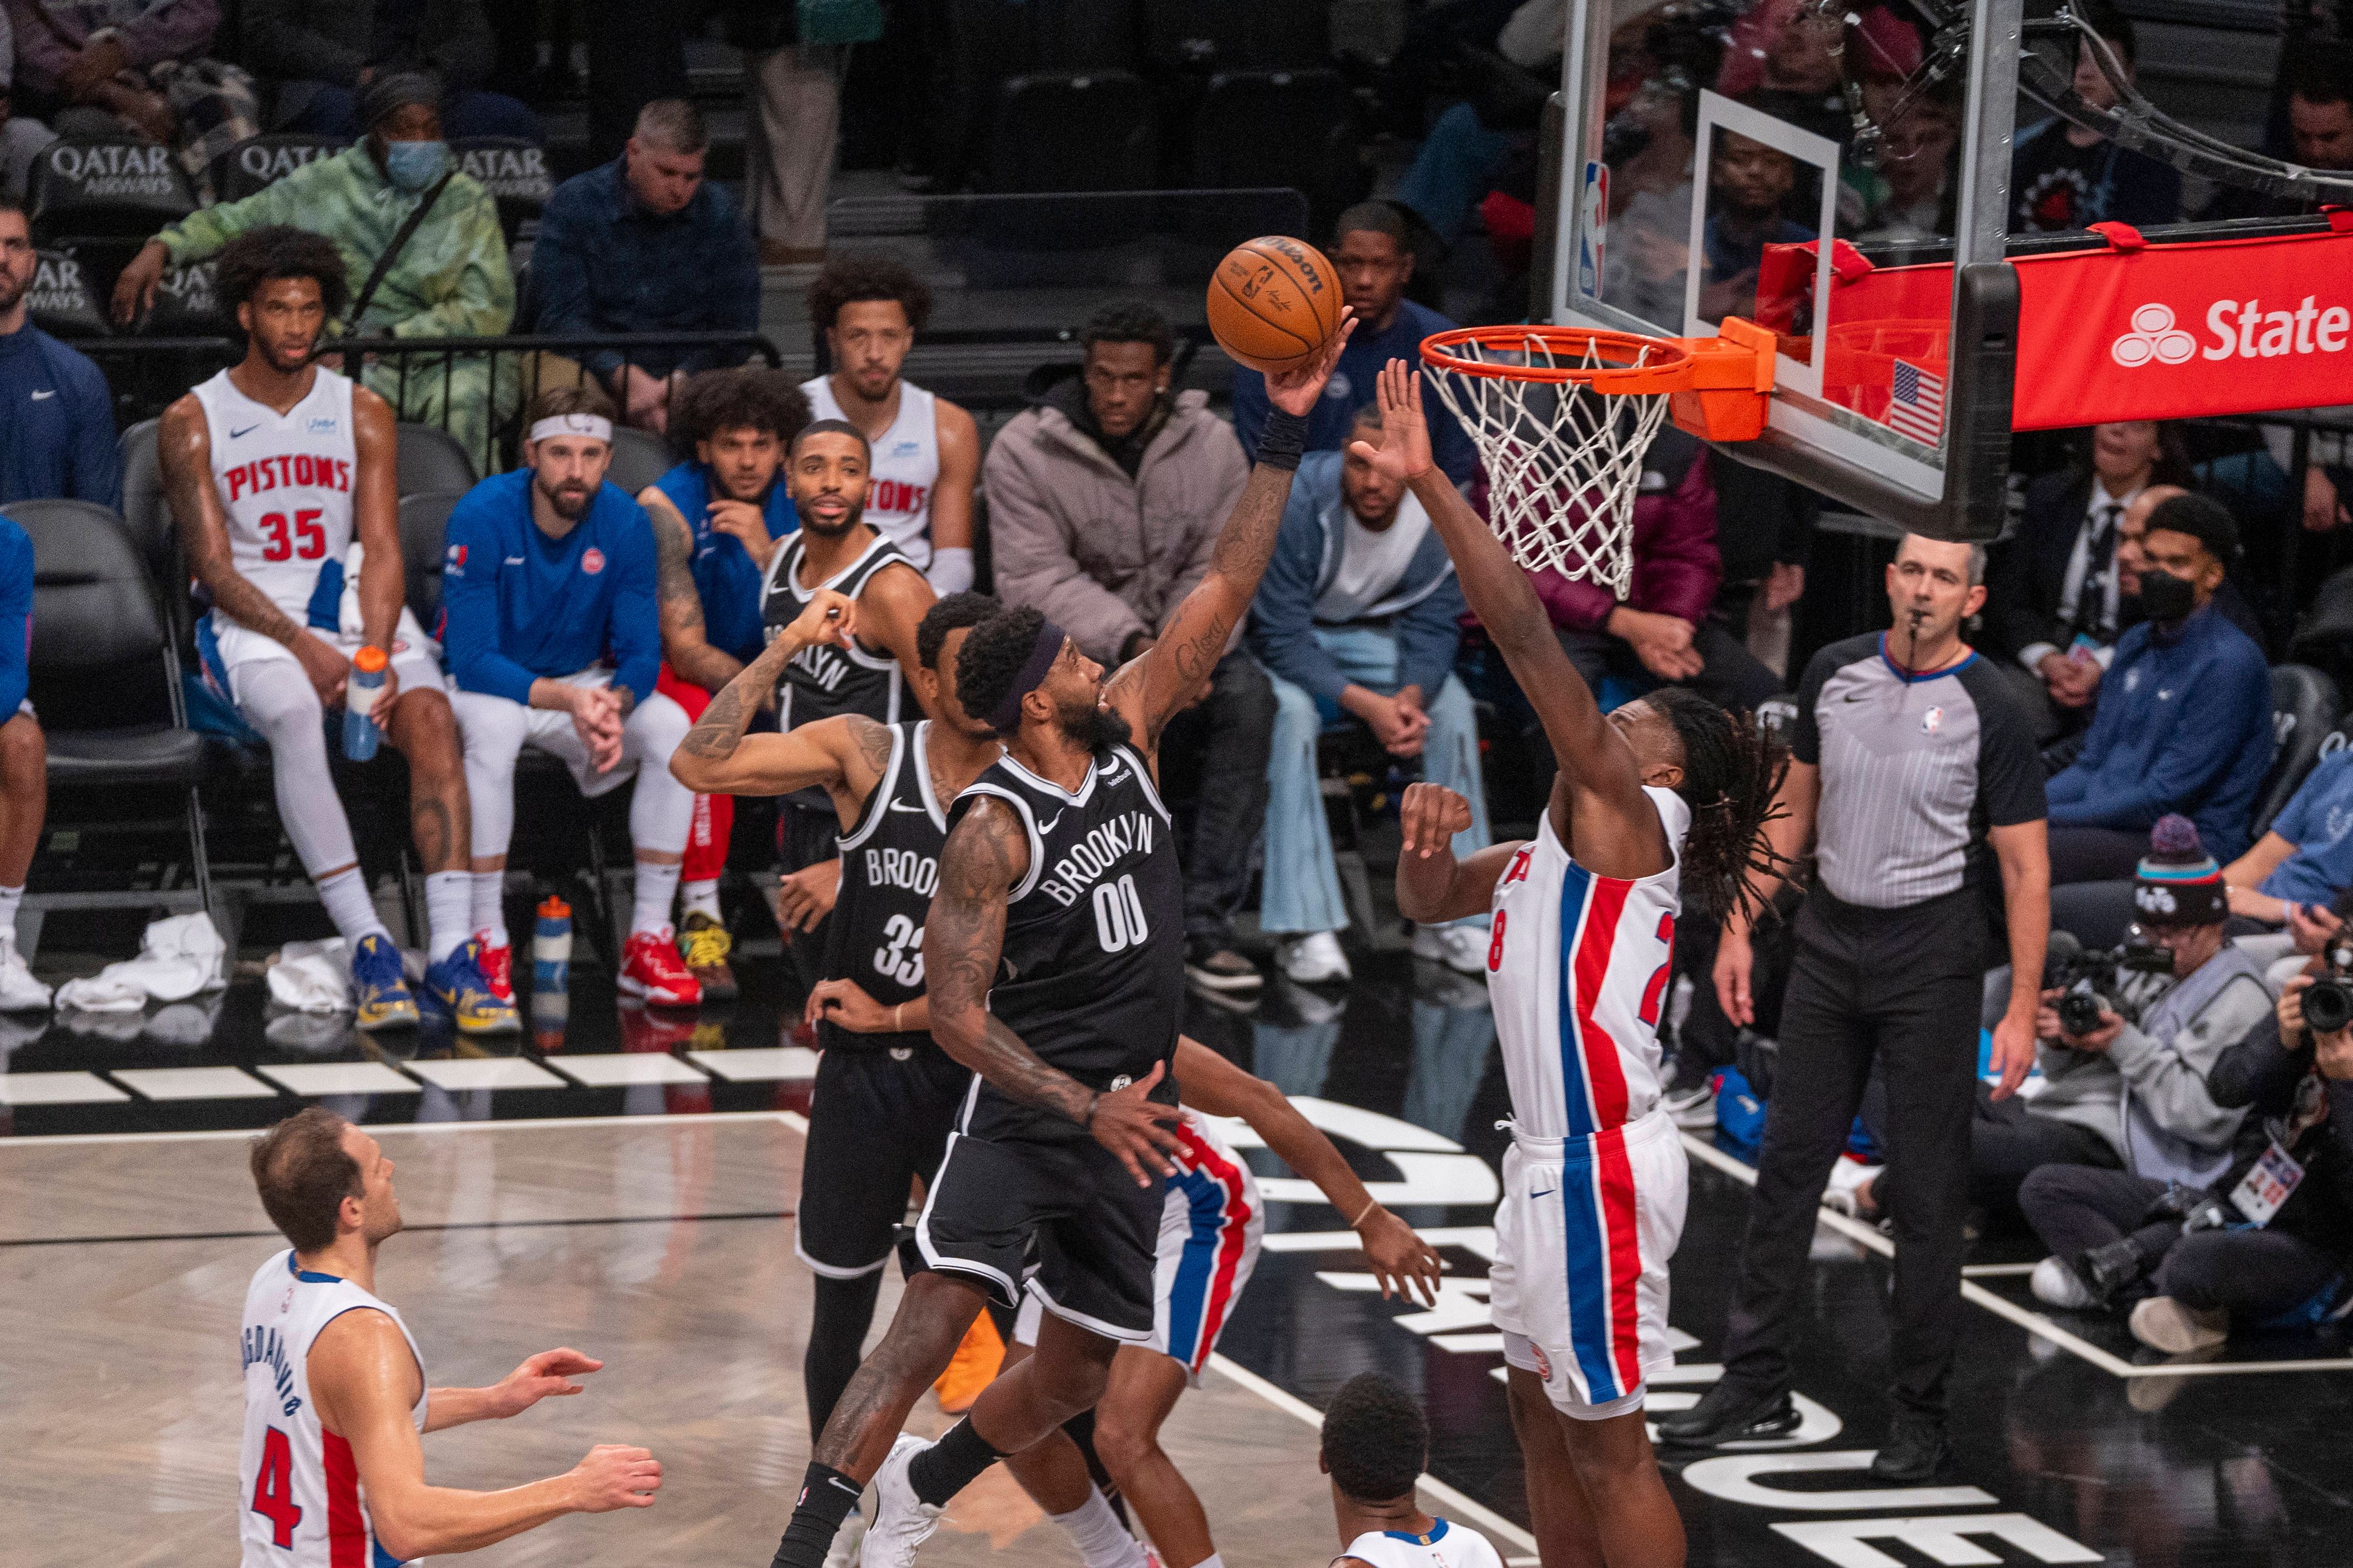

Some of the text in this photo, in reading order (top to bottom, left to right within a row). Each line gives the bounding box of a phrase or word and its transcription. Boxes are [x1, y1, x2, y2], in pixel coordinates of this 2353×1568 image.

[51, 146, 171, 182] QATAR
[239, 145, 348, 181] QAT
[449, 148, 548, 178] ATAR
[2202, 295, 2351, 361] State
[224, 453, 351, 501] PISTONS
[259, 508, 326, 561] 35
[865, 847, 940, 899] BROO
[1092, 874, 1148, 952] 00
[251, 1426, 302, 1551] 4
